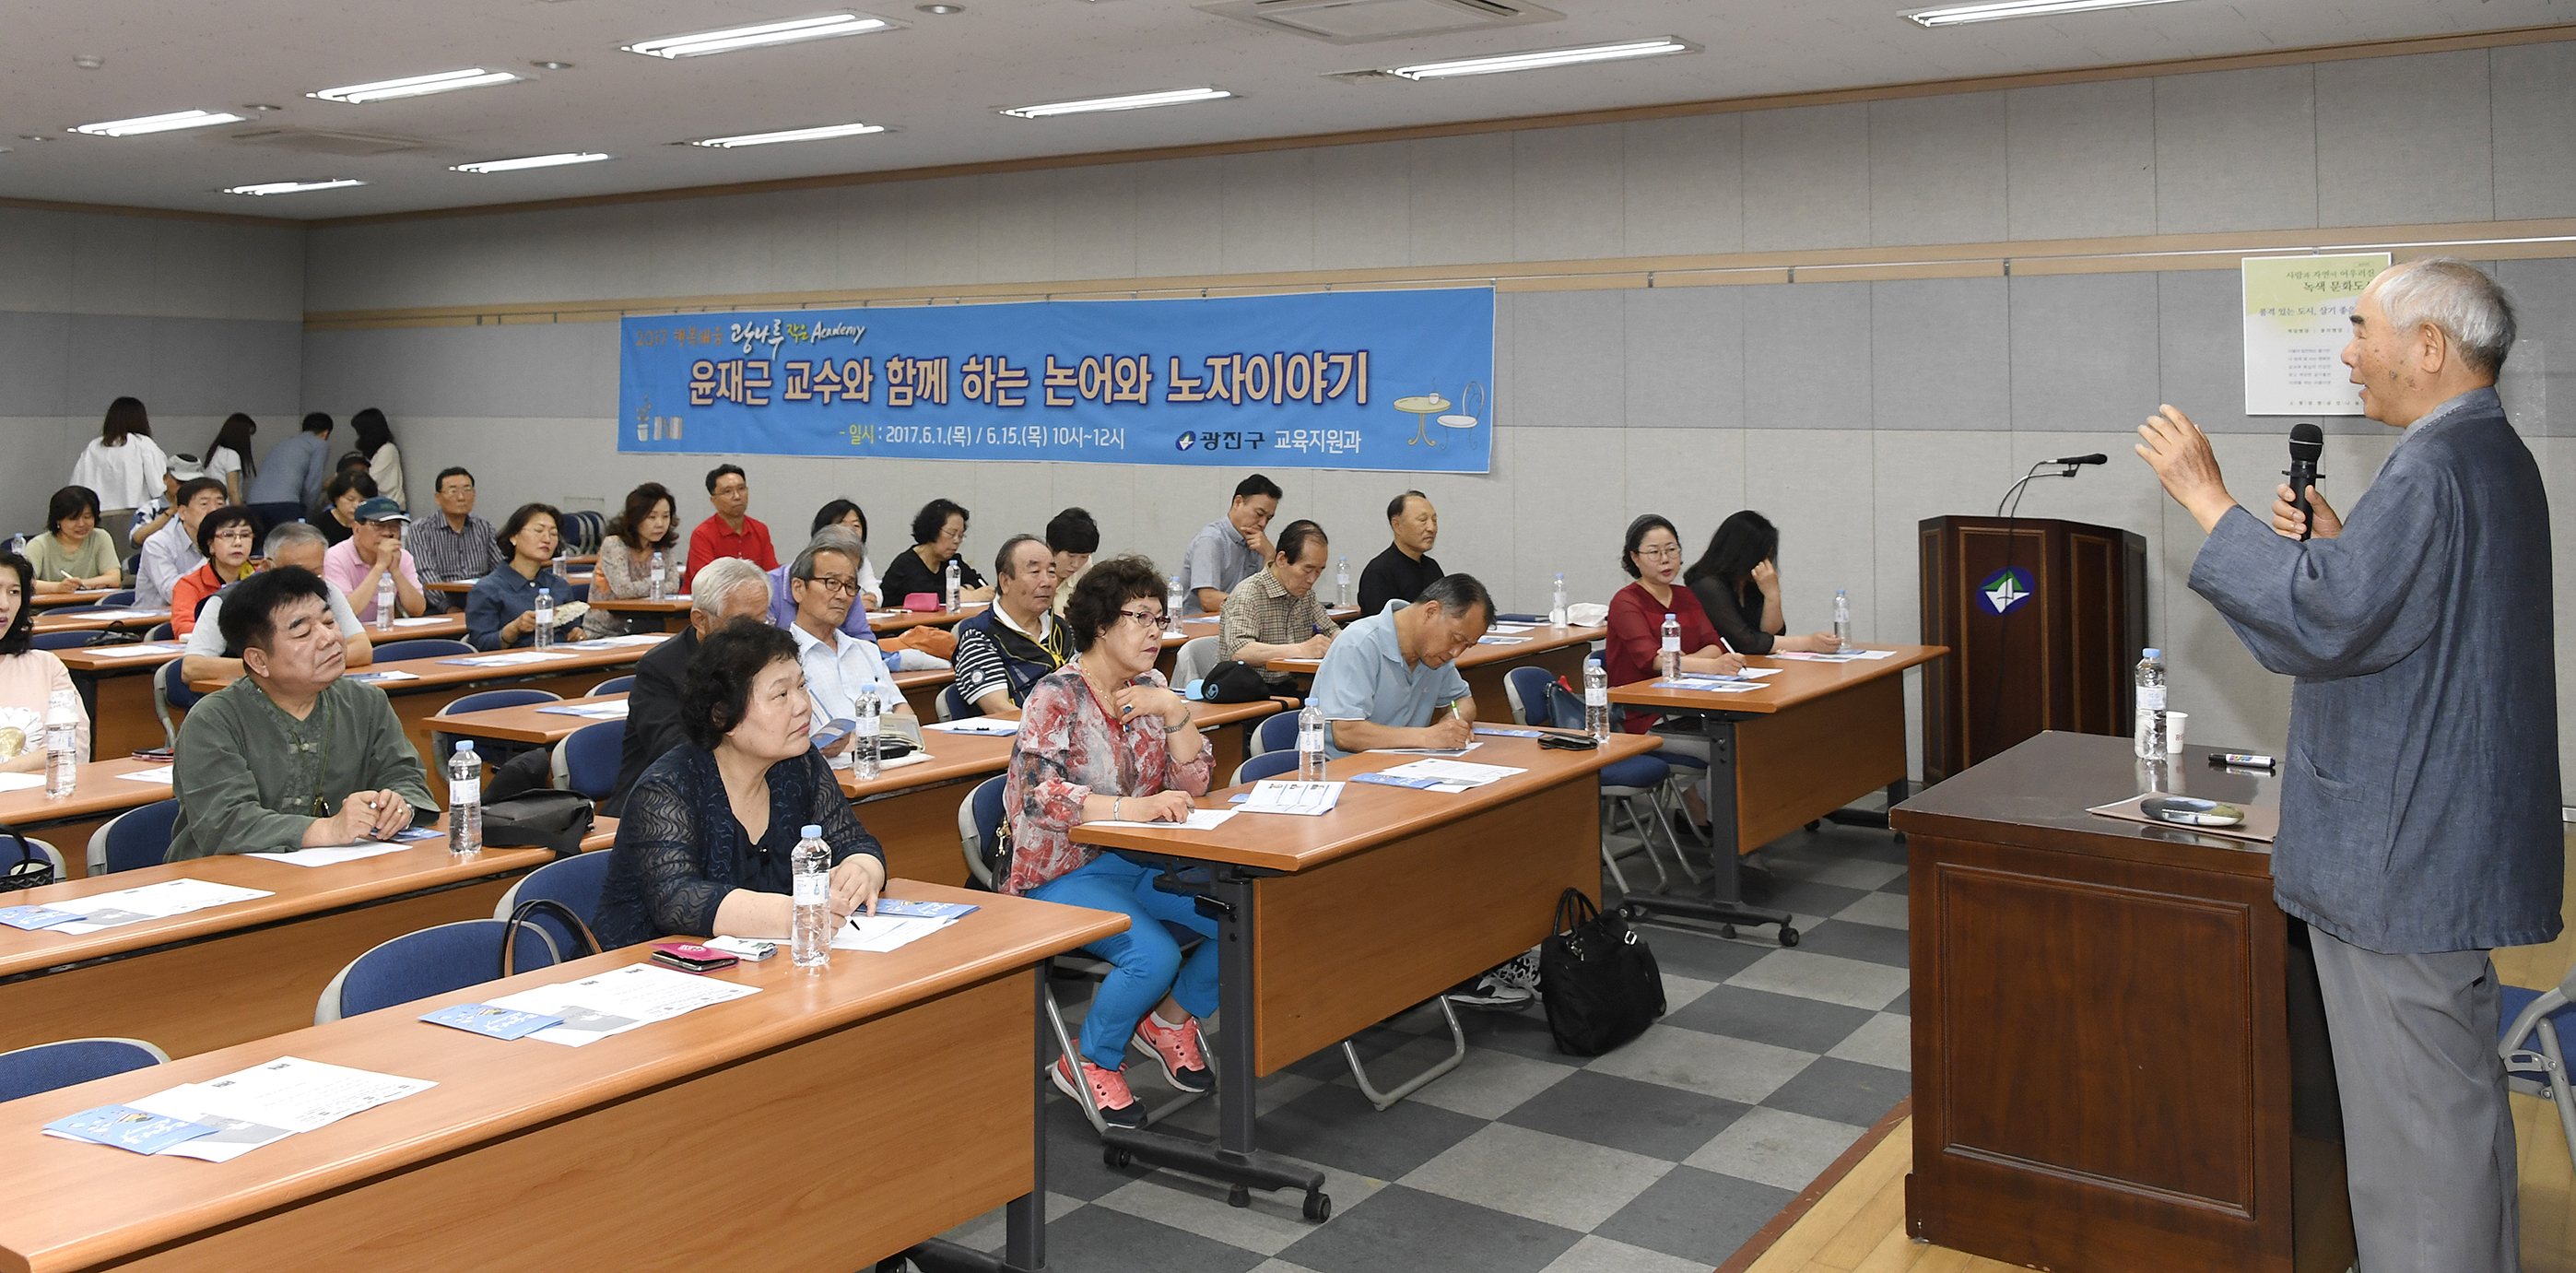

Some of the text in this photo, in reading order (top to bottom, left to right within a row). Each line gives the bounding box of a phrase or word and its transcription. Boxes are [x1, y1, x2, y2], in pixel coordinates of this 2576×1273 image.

[2303, 280, 2325, 292] 녹색
[2277, 307, 2295, 316] 있는
[2319, 306, 2336, 315] 살기
[636, 319, 866, 361] 2017 행복배움 광나루 작은 Academy
[689, 349, 1370, 407] 윤재근 교수와 함께 하는 논어와 노자이야기
[849, 424, 875, 445] 일시
[886, 425, 971, 446] 2017.6.1.(목)
[986, 426, 1048, 447] 6.15.(목)
[1053, 426, 1124, 450] 10시~12시
[1200, 428, 1362, 454] 광진구 교육지원과
